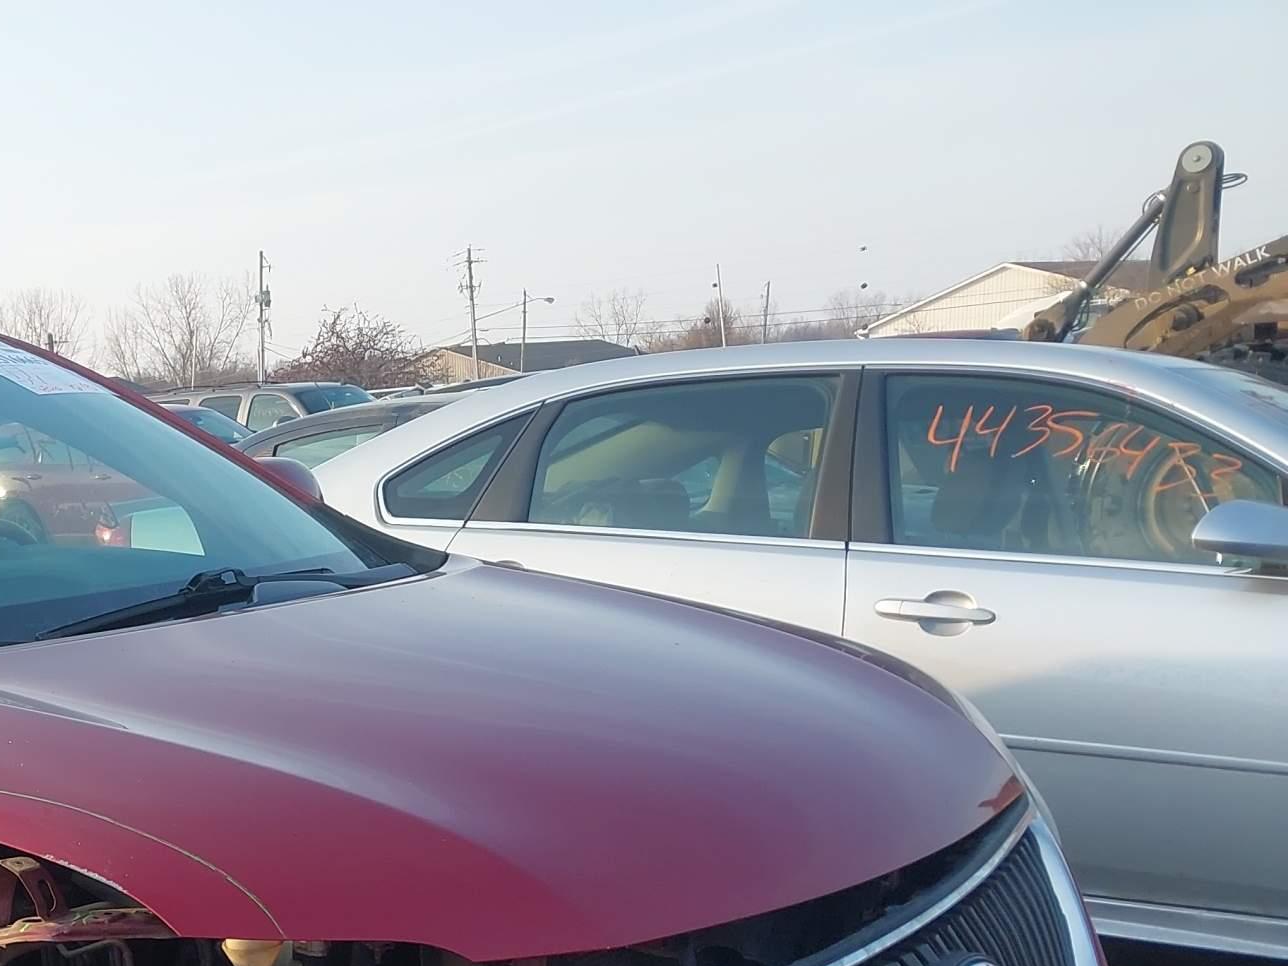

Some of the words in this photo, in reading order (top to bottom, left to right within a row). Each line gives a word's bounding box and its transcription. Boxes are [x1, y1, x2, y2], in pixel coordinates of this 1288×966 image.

[1134, 290, 1162, 312] DO
[1166, 269, 1208, 297] NOT
[1211, 245, 1272, 279] WALK
